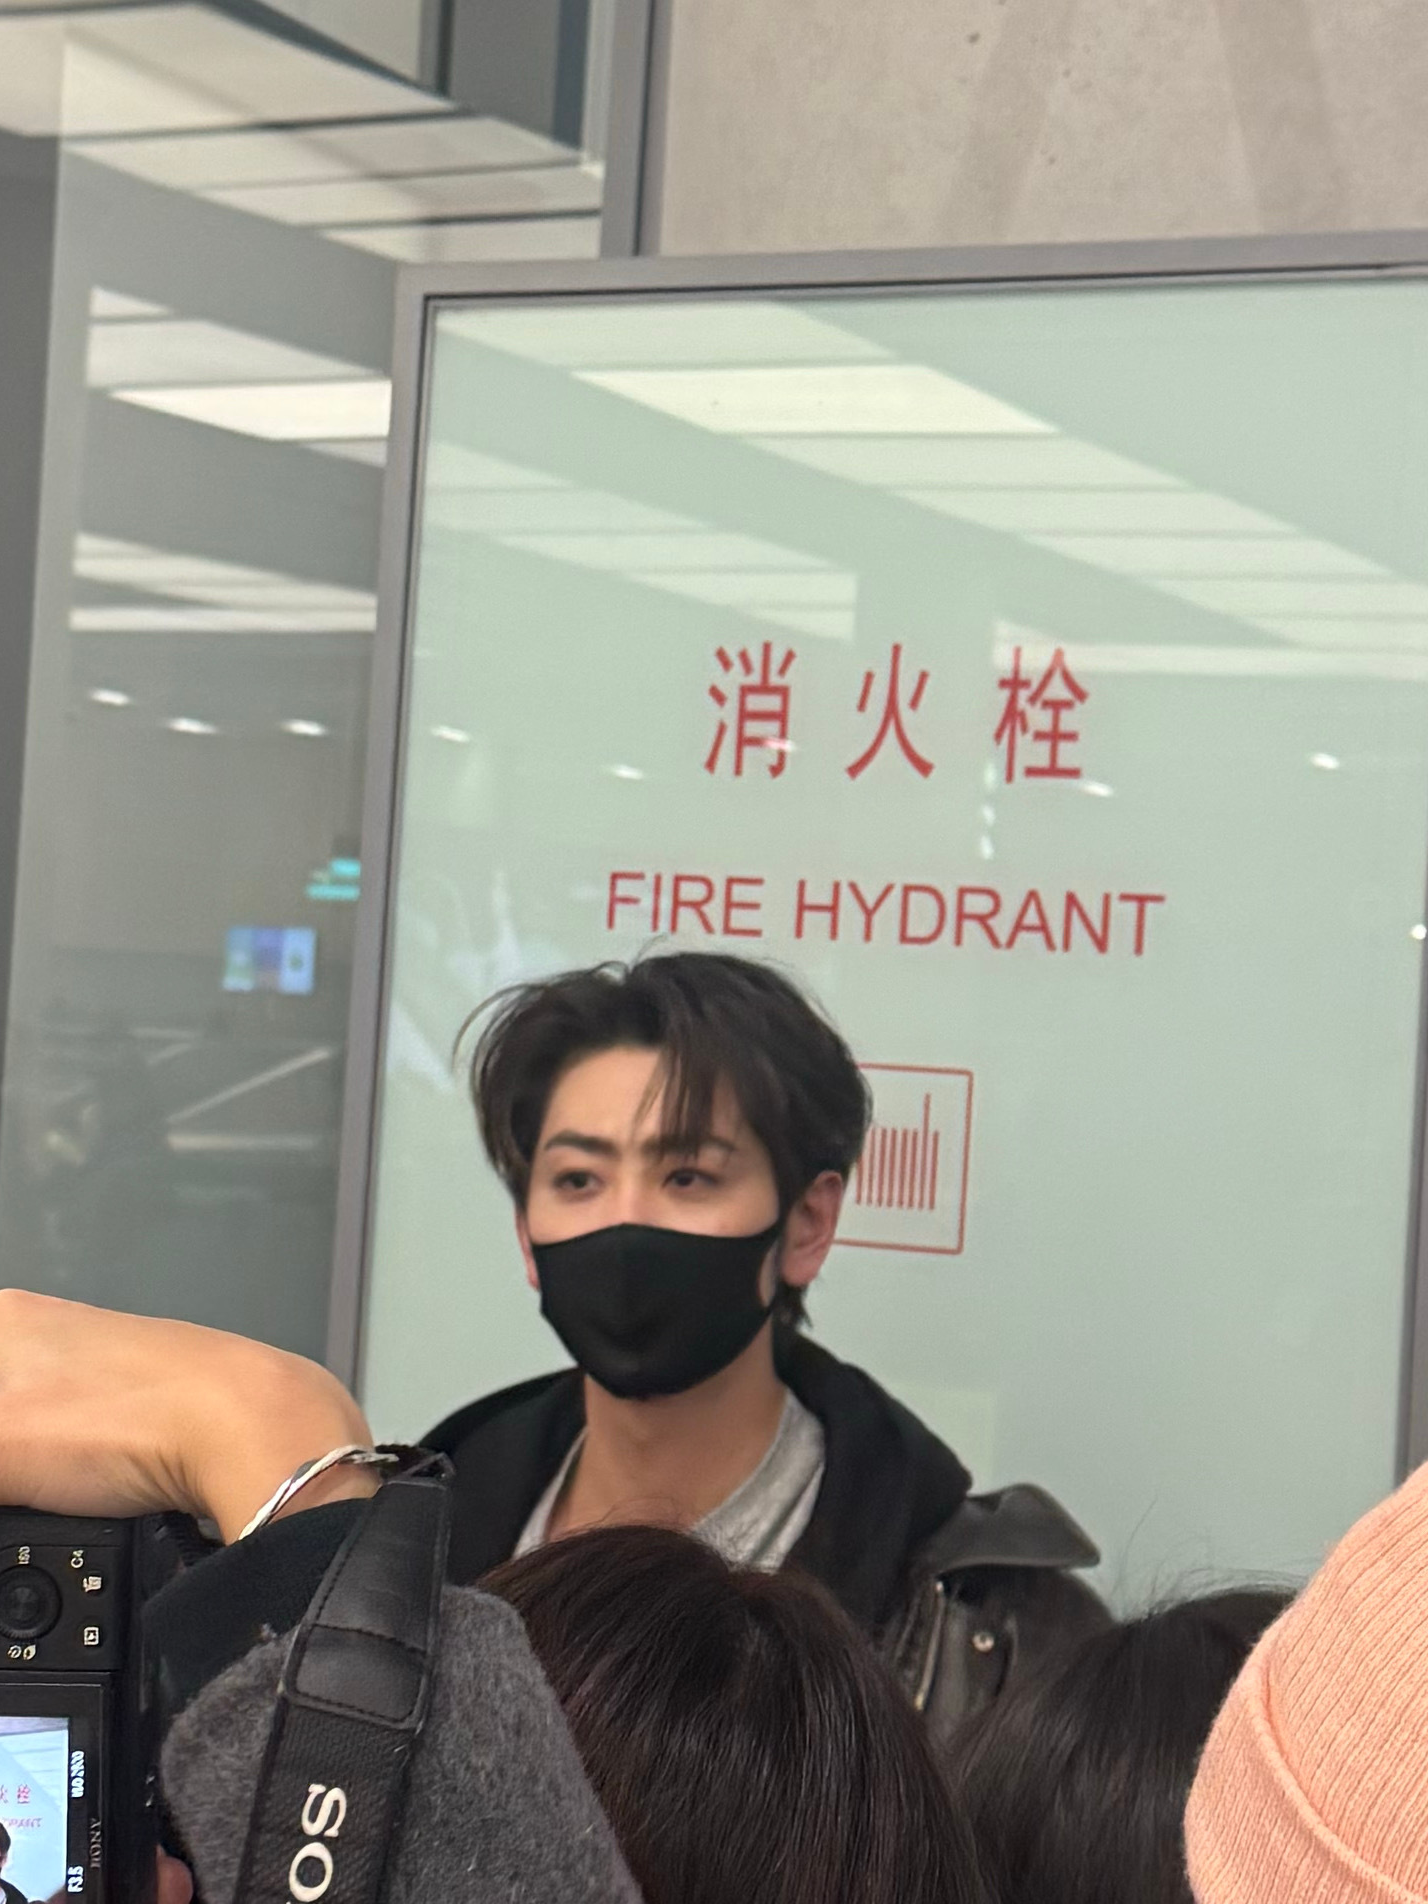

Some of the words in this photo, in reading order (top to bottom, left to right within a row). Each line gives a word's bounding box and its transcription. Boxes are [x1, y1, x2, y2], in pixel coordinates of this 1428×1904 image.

[703, 640, 1091, 784] 消火栓
[606, 871, 765, 938] FIRE
[794, 878, 1166, 957] HYDRANT
